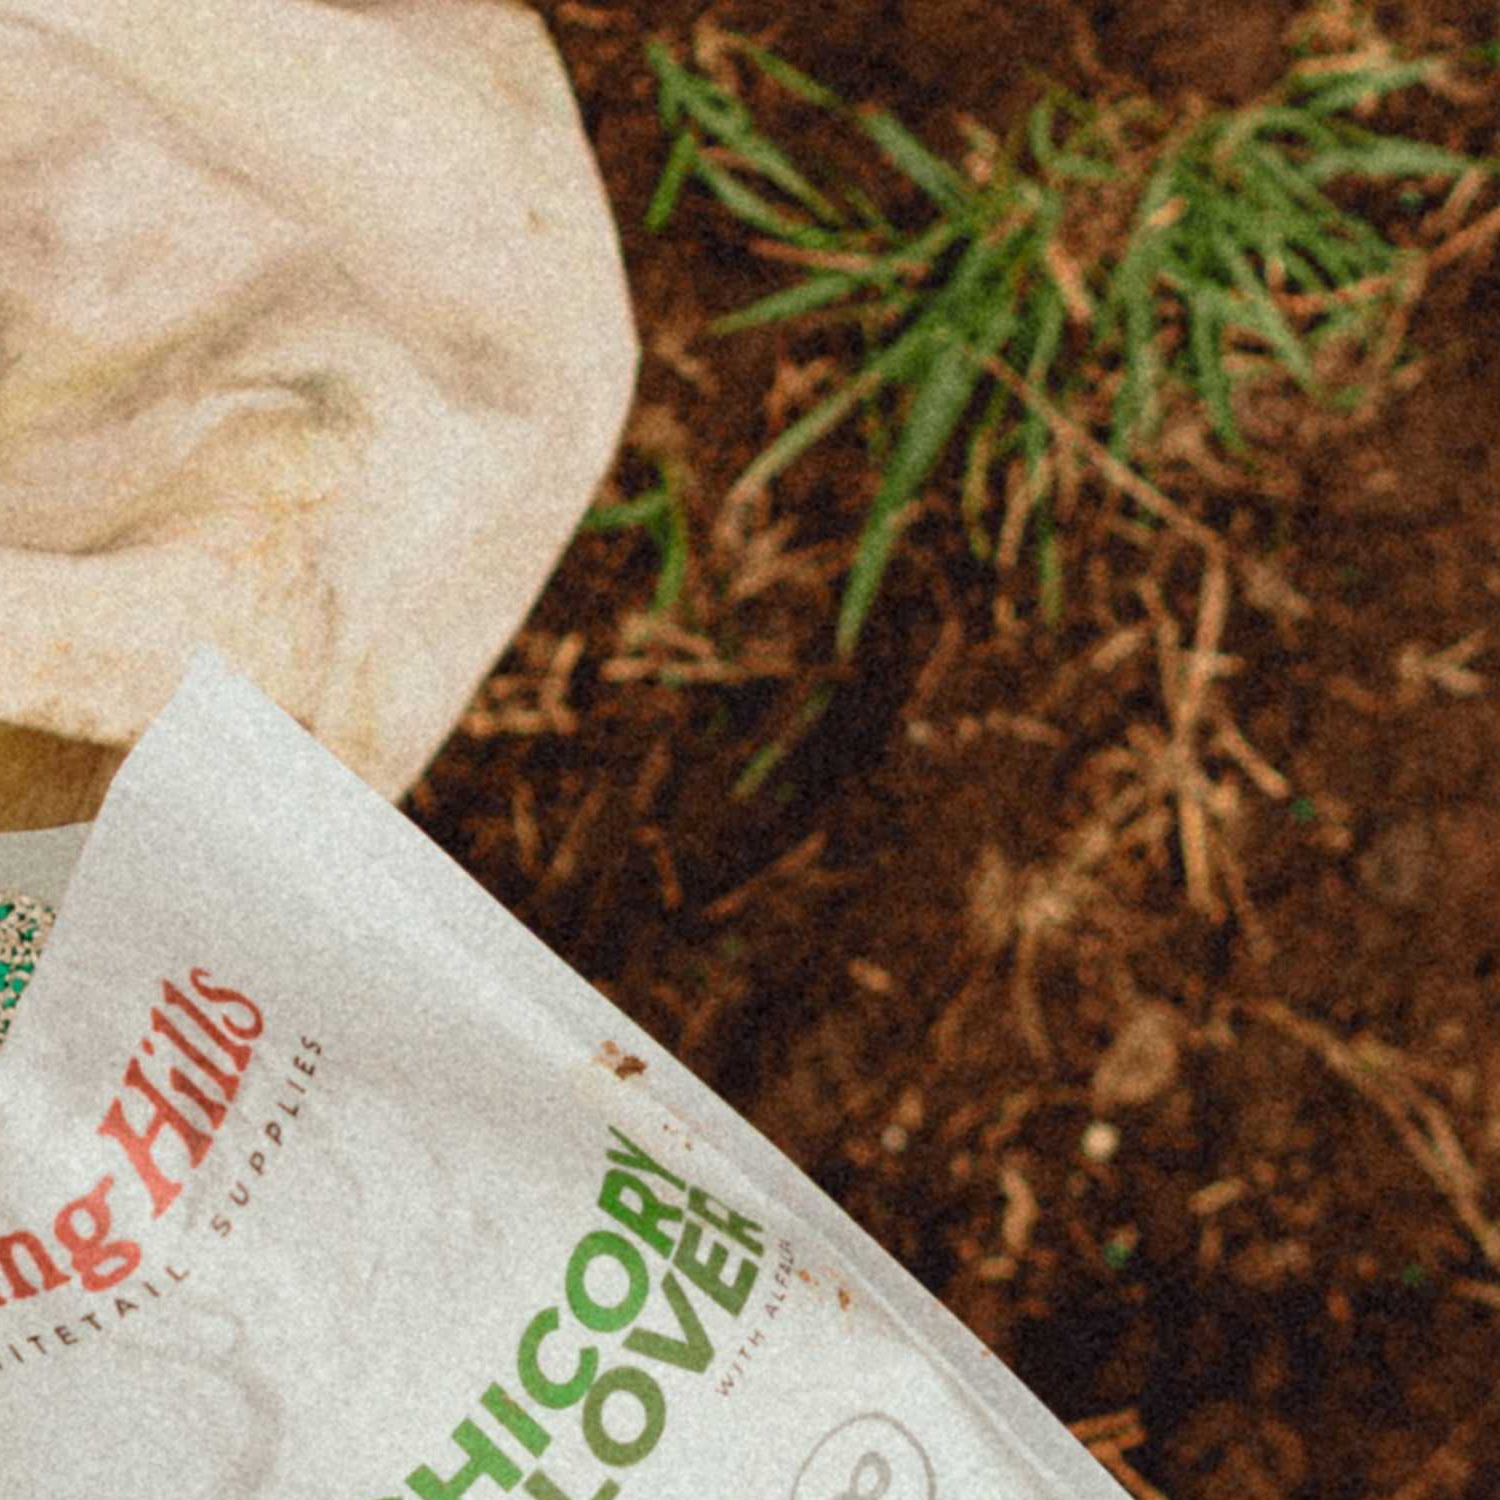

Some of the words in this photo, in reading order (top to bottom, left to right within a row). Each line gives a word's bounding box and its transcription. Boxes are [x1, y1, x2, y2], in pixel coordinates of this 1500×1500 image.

[97, 967, 263, 1219] Hills
[210, 1034, 322, 1239] SUPPLIES
[715, 1328, 765, 1396] WITH
